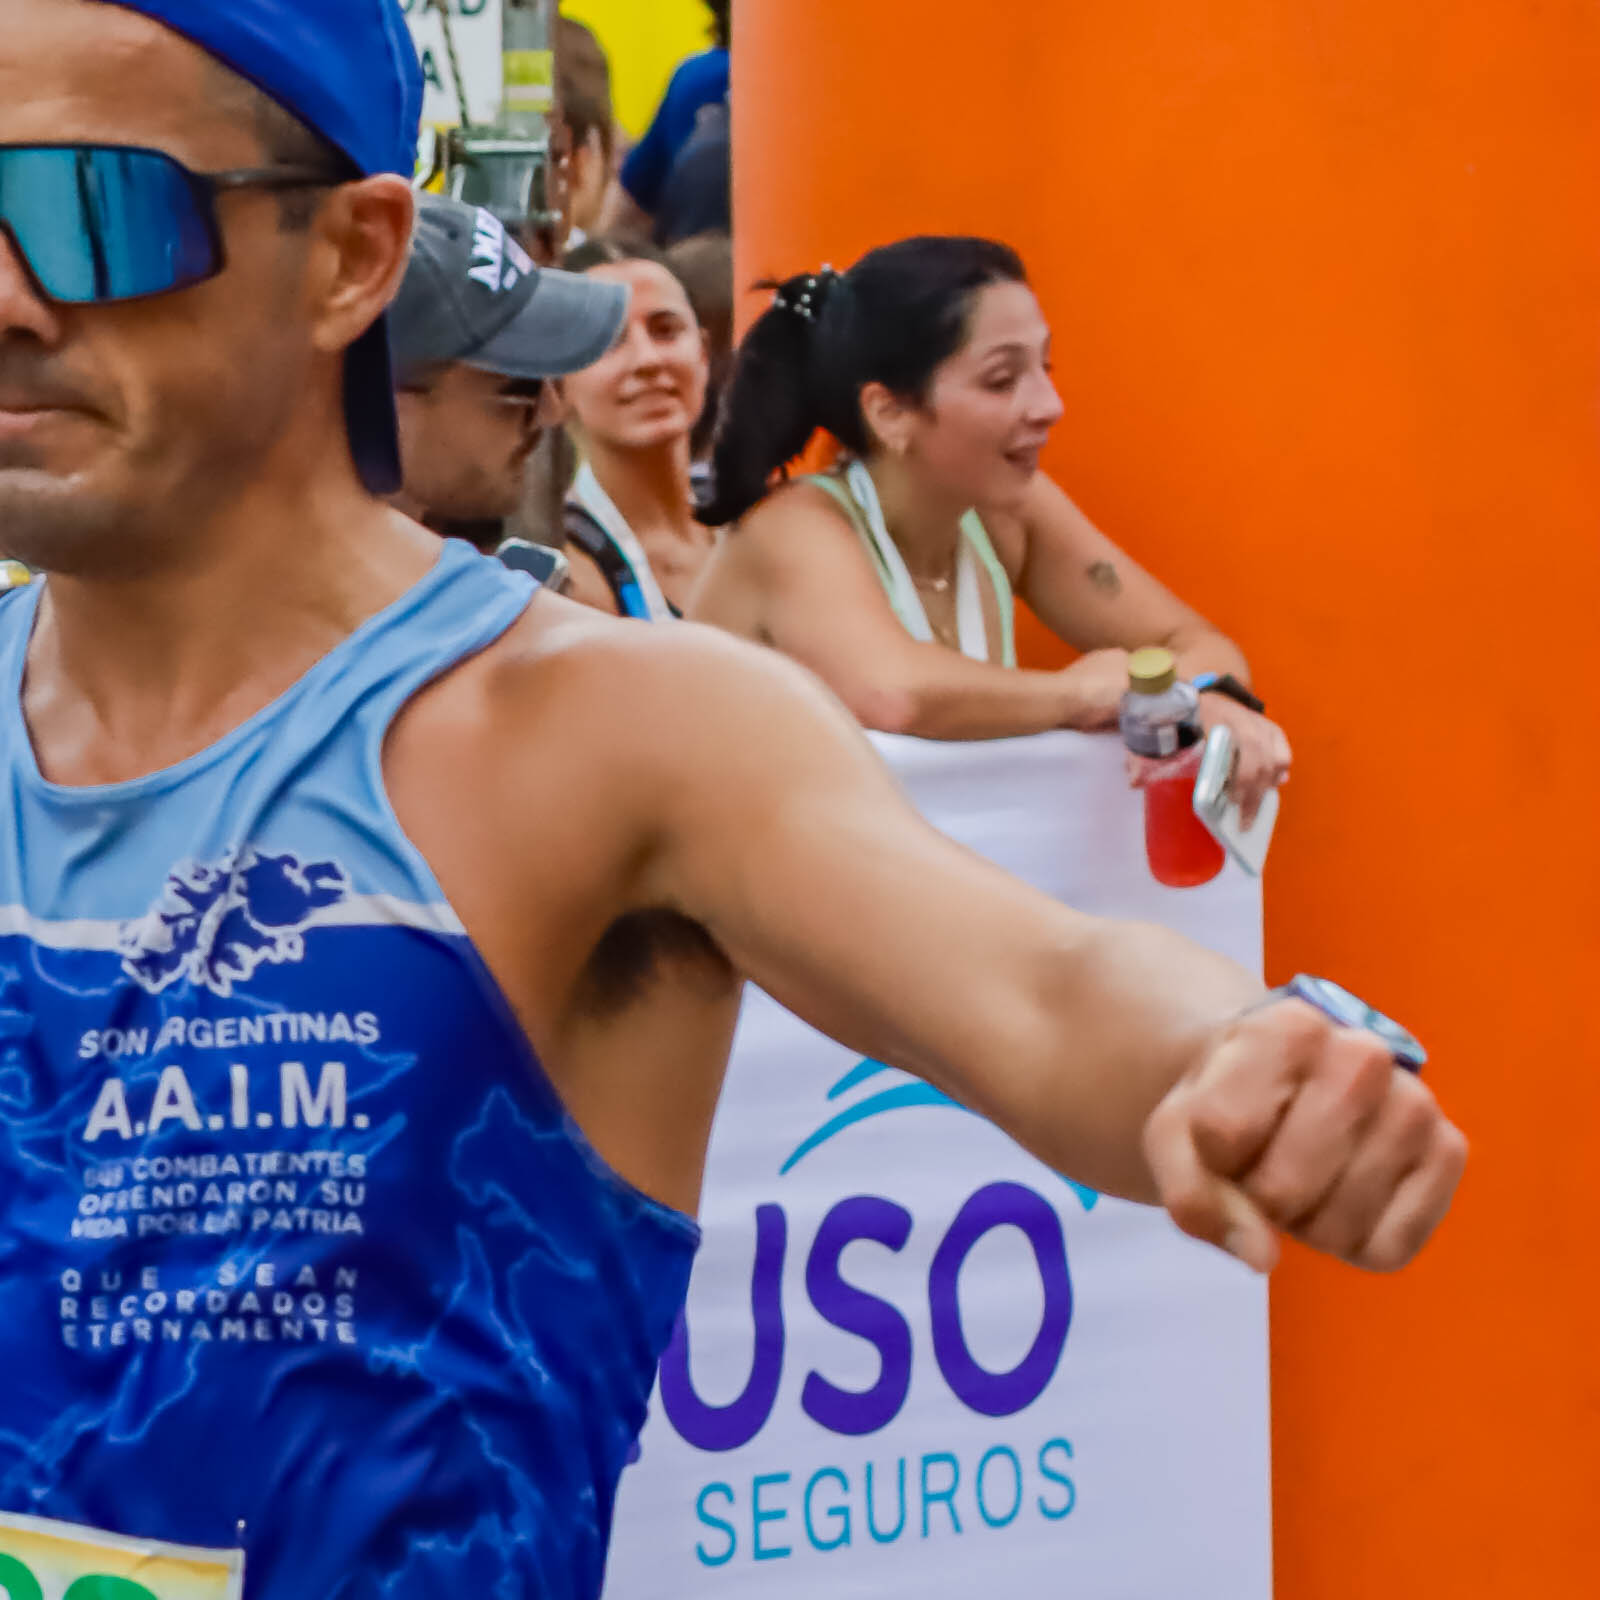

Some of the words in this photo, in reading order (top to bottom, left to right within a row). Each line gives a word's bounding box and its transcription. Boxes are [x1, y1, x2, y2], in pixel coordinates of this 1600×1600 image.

[79, 1027, 148, 1059] SON
[152, 1011, 380, 1055] ARGENTINAS
[82, 1061, 370, 1142] A.A.I.M.
[132, 1151, 367, 1180] COMBATIENTES
[321, 1179, 366, 1206] SU
[137, 1212, 199, 1237] POR
[252, 1208, 364, 1235] PATRIA
[60, 1266, 159, 1292] QUE
[217, 1262, 358, 1288] SEAN
[60, 1290, 356, 1321] RECORDADOS
[656, 1179, 1074, 1452] USO
[61, 1317, 358, 1349] ETERNAMENTE
[695, 1437, 1077, 1567] SEGUROS
